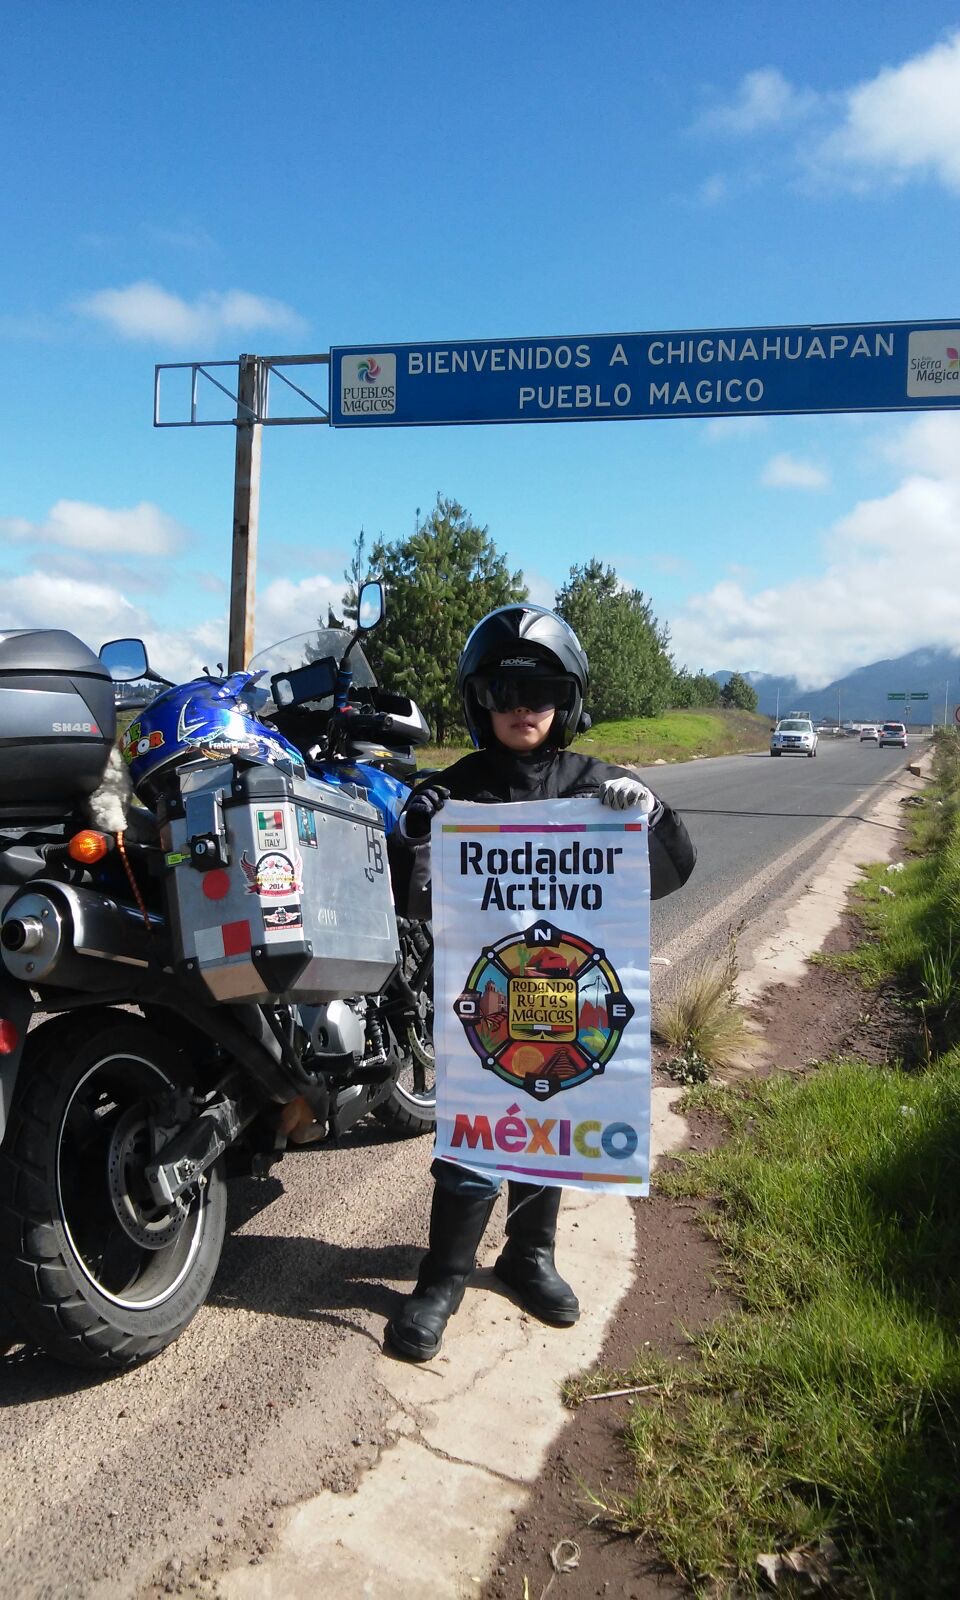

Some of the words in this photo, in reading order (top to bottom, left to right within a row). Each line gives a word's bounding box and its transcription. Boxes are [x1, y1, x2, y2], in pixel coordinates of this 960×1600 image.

[408, 344, 591, 375] BIENVENIDOS
[609, 343, 629, 366] A
[647, 333, 895, 365] CHIGNAHUAPAN
[911, 358, 942, 370] Sierra
[916, 369, 959, 384] Mágica
[343, 386, 395, 400] PUEBLOS
[518, 383, 632, 409] PUEBLO
[649, 378, 764, 405] MAGICO
[264, 839, 280, 847] ITALY
[460, 841, 623, 875] Rodador
[480, 875, 603, 911] Activo
[534, 928, 551, 941] N
[512, 981, 574, 993] RODANDO
[459, 1000, 476, 1015] O
[517, 995, 568, 1009] RUTAS
[612, 1003, 627, 1017] E
[534, 1079, 550, 1093] S
